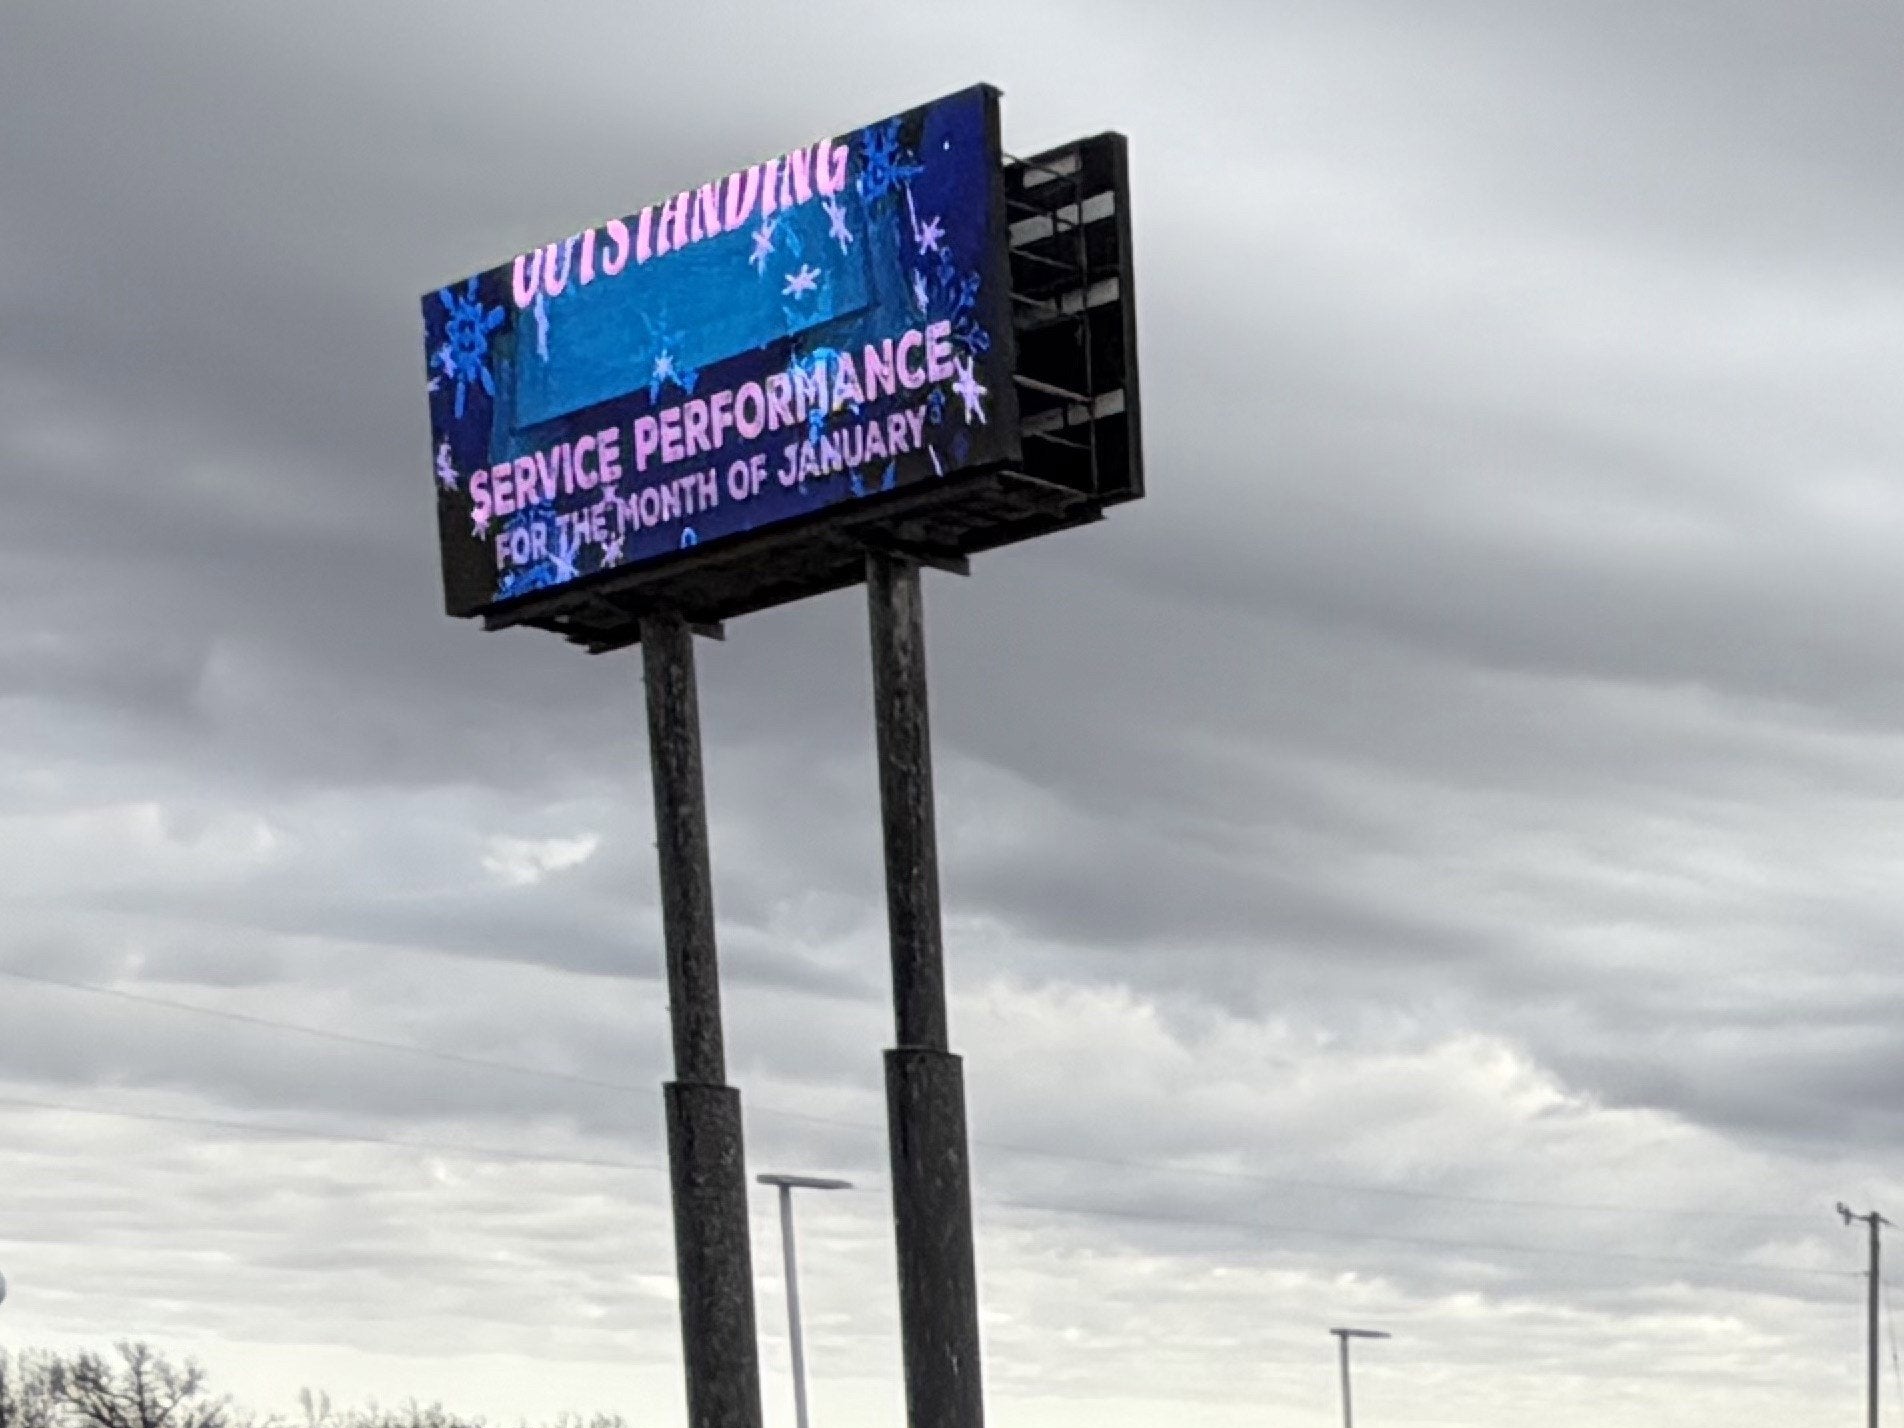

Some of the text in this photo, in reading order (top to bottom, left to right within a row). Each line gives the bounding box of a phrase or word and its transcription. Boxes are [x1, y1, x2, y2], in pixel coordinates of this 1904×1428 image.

[469, 321, 954, 517] SERVICE PERFORMANCE
[495, 404, 927, 570] FOR THE MONTH OF JANUARY
